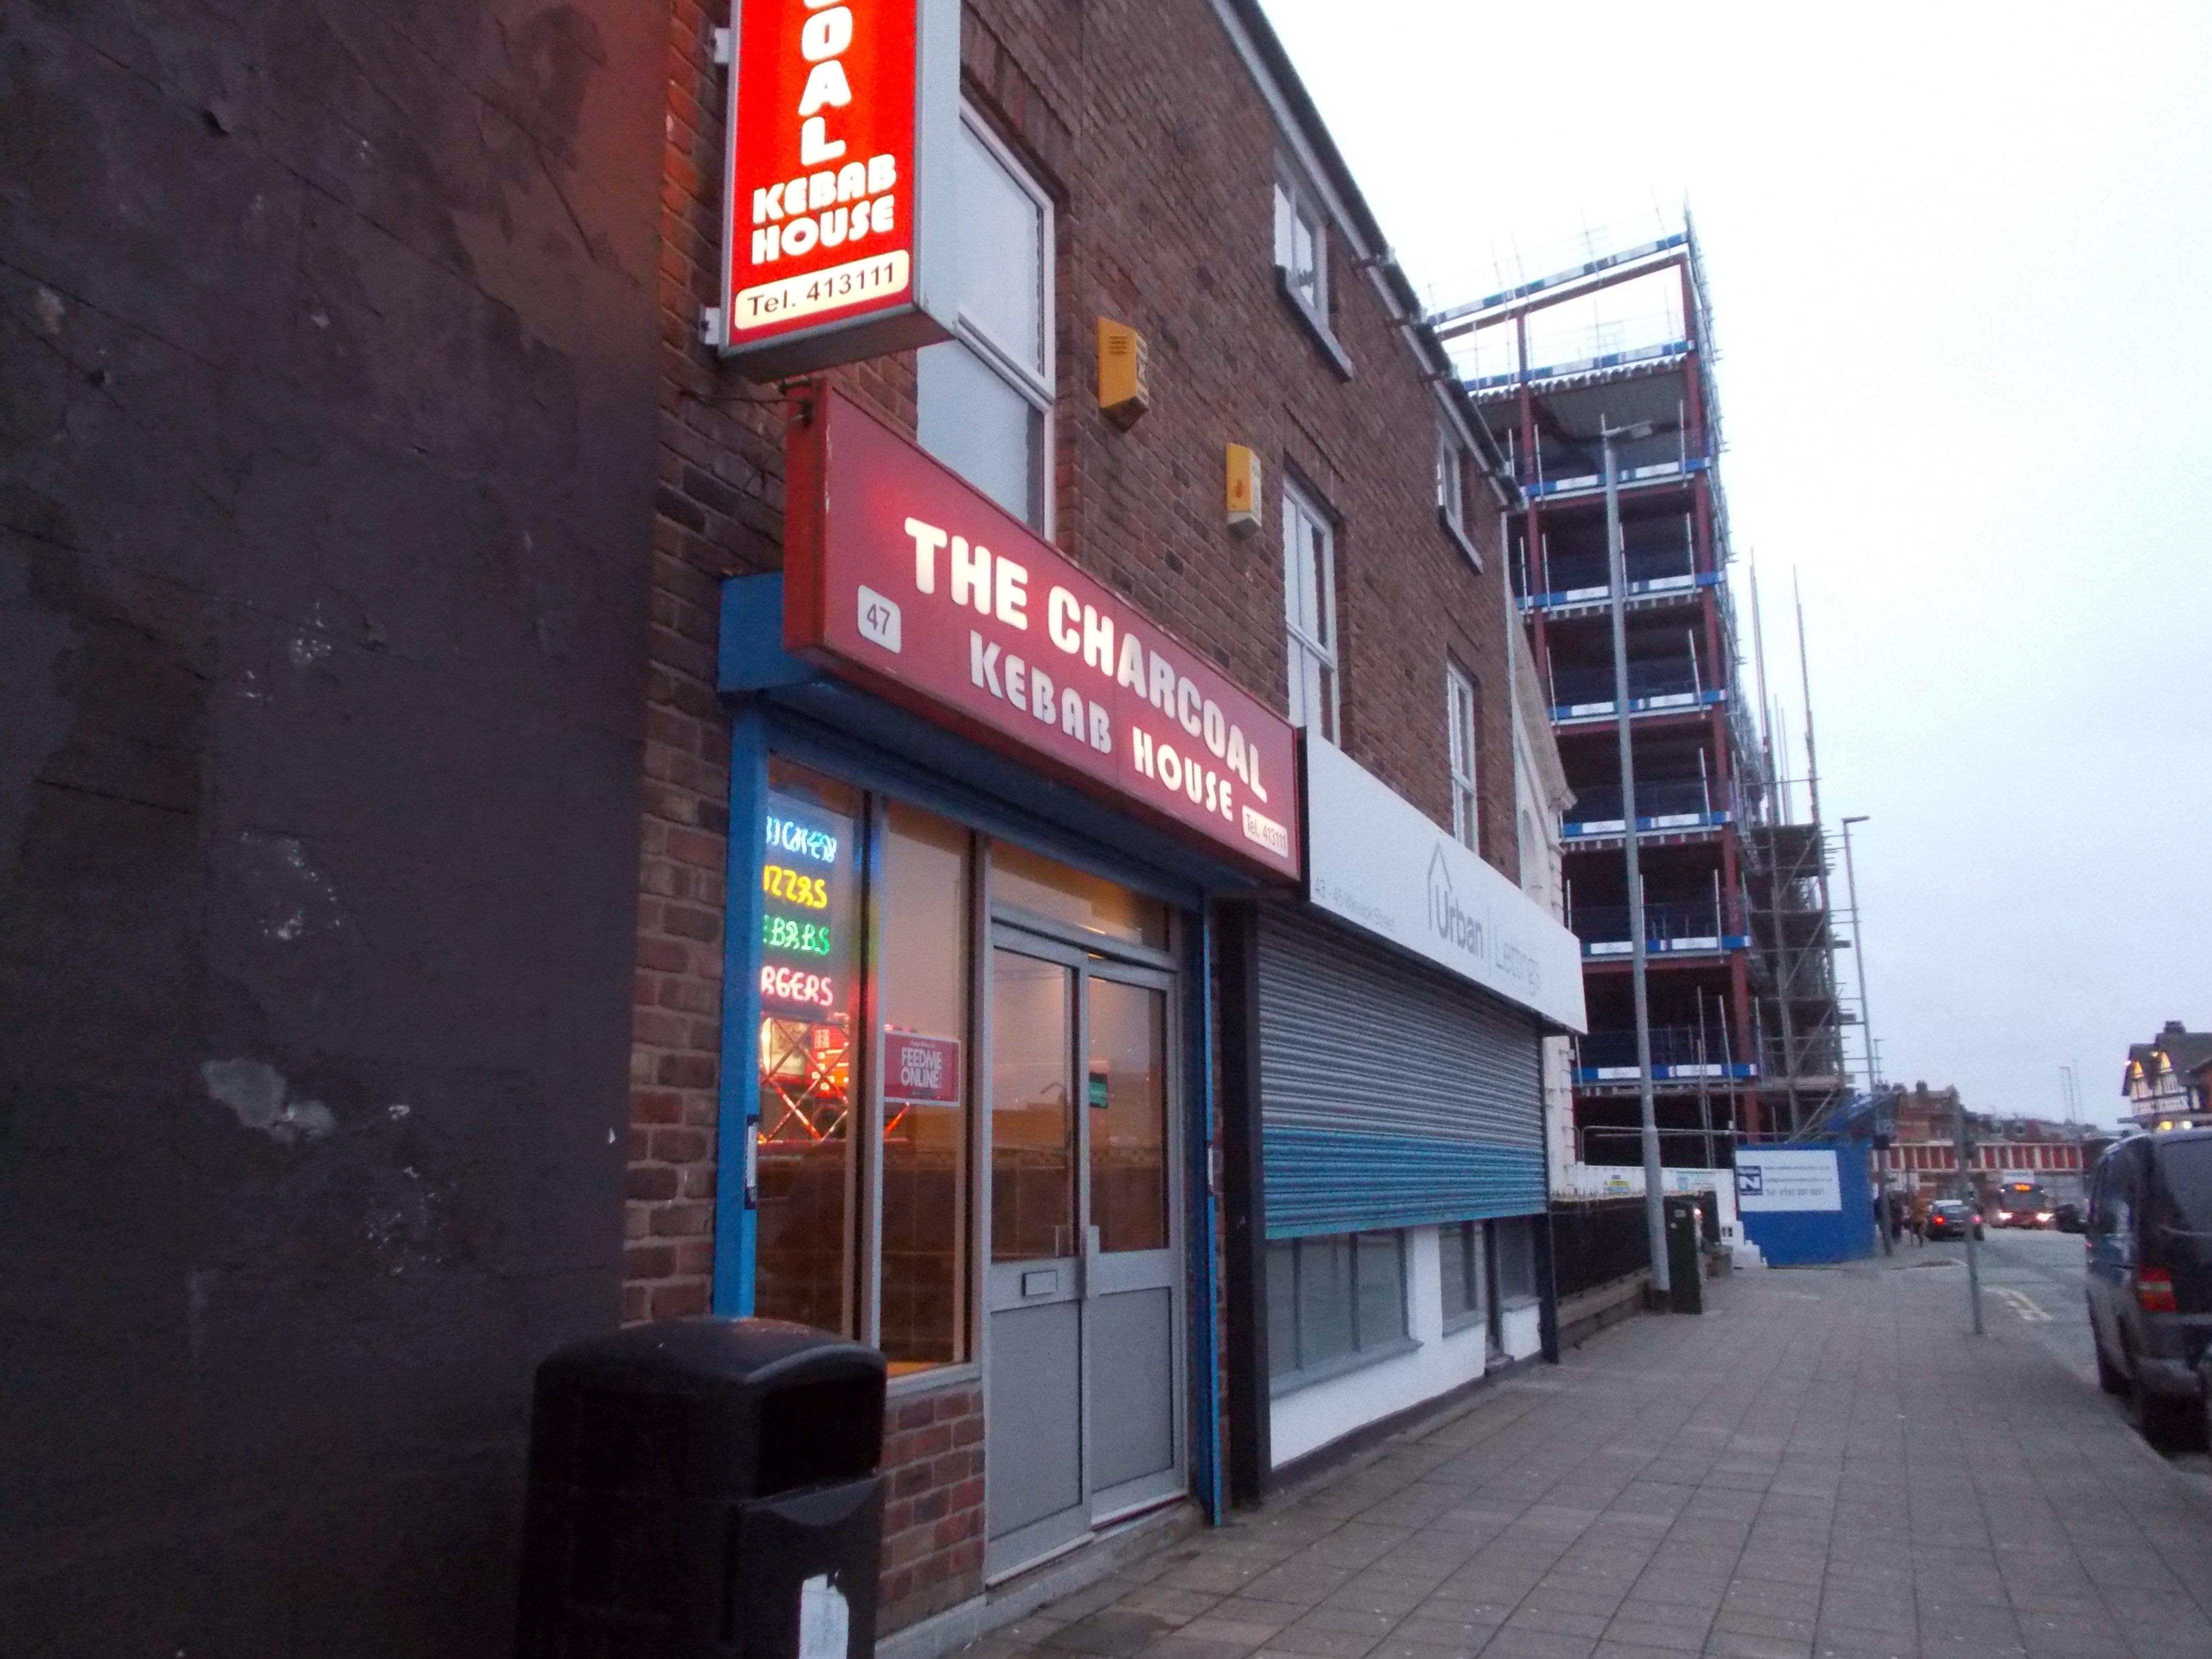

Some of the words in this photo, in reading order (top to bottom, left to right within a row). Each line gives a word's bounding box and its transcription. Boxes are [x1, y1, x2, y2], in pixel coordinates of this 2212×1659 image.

[798, 0, 853, 166] OAL
[753, 154, 897, 225] KEBAB
[751, 194, 896, 265] HOUSE
[747, 289, 797, 317] Tel.
[806, 261, 895, 302] 413111
[867, 603, 891, 635] 47
[904, 516, 1028, 631] THE
[1048, 585, 1268, 803] CHARCOAL
[970, 629, 1112, 754] KEBAB
[1132, 726, 1234, 821] HOUSE
[1262, 824, 1286, 852] 413111
[1314, 877, 1325, 898] 43
[1435, 885, 1484, 959] Urban
